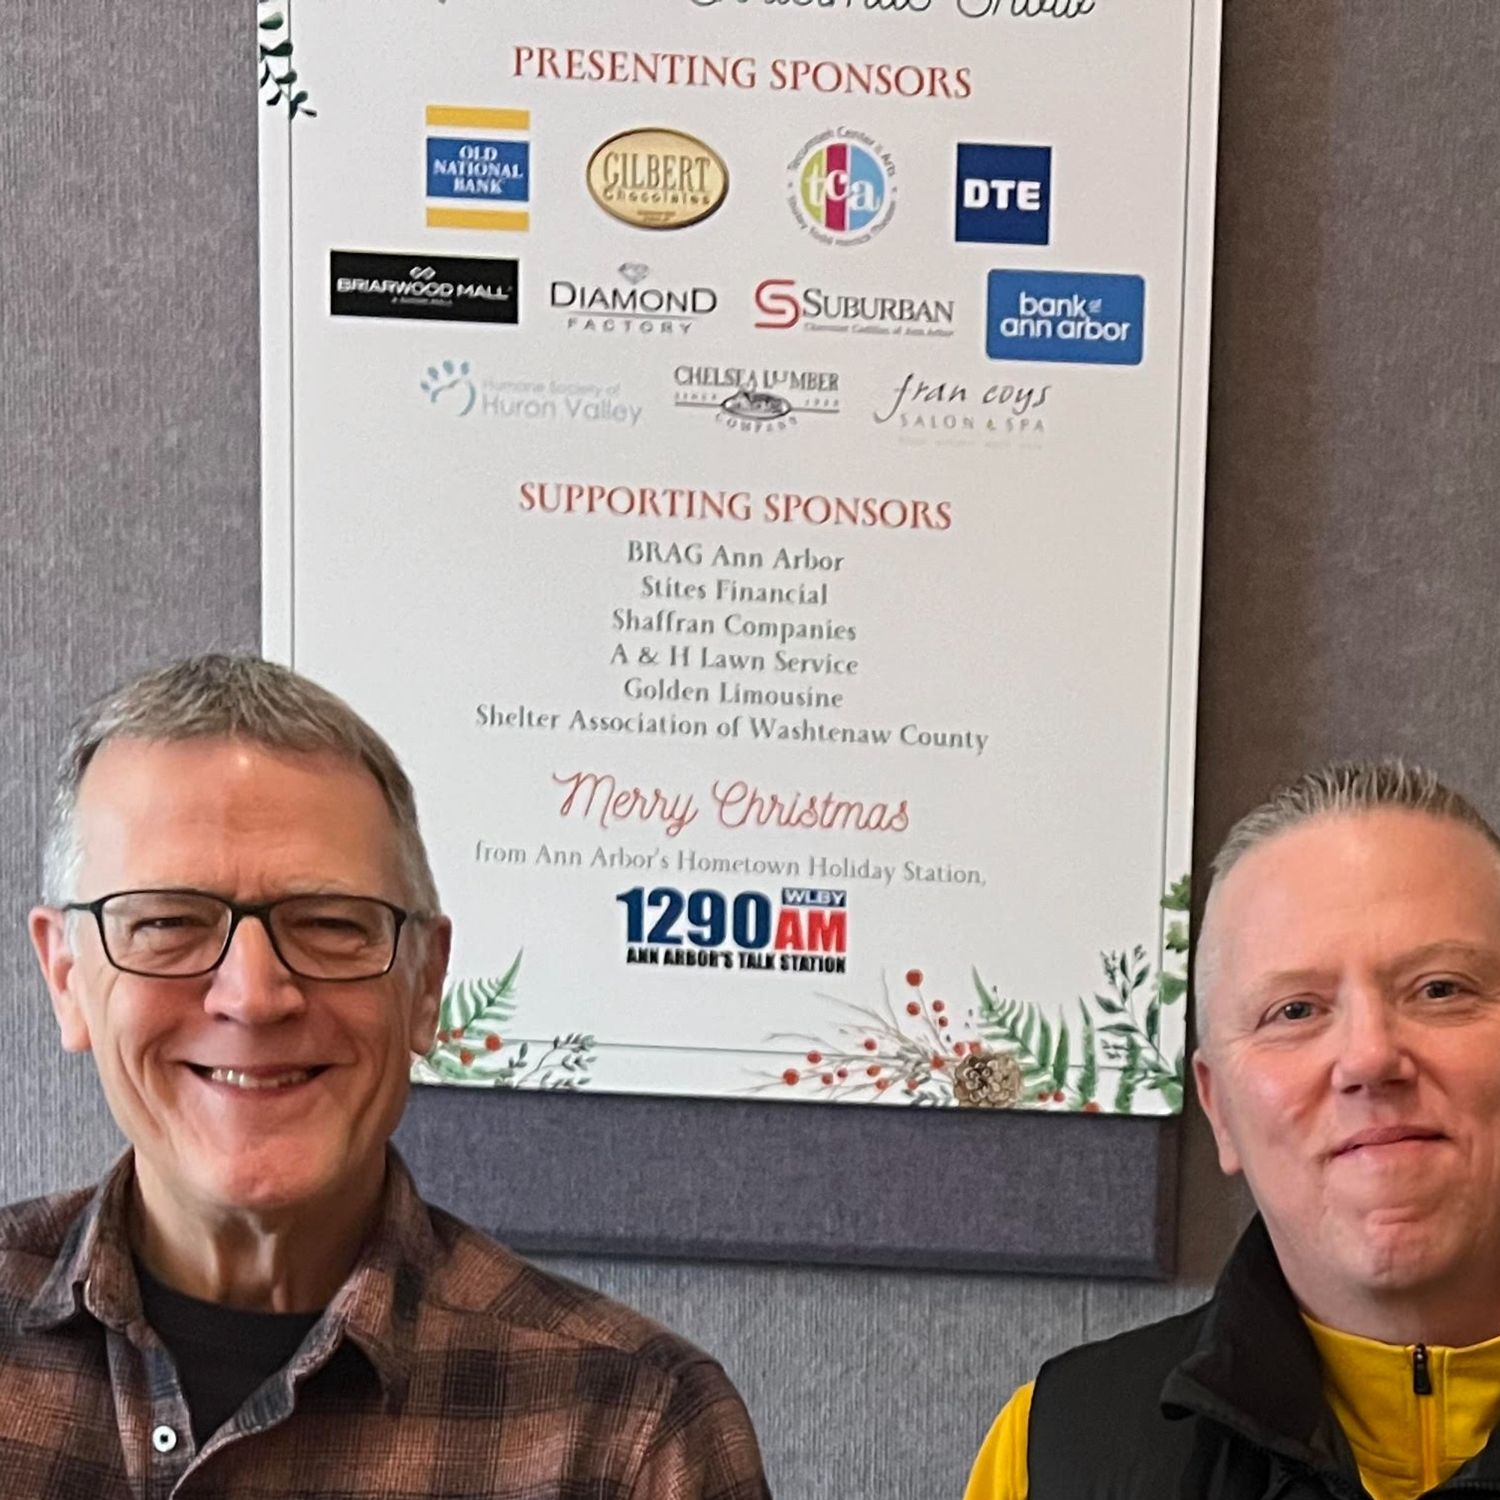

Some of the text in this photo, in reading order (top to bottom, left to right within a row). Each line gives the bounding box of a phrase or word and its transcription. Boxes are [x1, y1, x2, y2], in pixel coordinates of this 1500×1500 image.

[513, 46, 971, 98] PRESENTING SPONSORS
[459, 145, 498, 161] OLD
[434, 159, 523, 179] NATIONAL
[603, 151, 711, 193] GILBERT
[453, 177, 502, 194] BANK
[806, 162, 880, 212] tca
[963, 178, 1040, 210] DTE
[337, 277, 454, 298] BRIARWOOD
[457, 283, 509, 301] MALL
[551, 281, 718, 315] DIAMOND
[1019, 290, 1088, 319] bank
[803, 288, 955, 323] SUBURBAN
[567, 318, 693, 335] FACTORY
[1000, 317, 1131, 342] ann arbor
[763, 369, 840, 392] LUMBER
[481, 394, 643, 425] Huron Valley
[873, 373, 1052, 424] fran coys
[900, 412, 975, 430] SALON
[1005, 416, 1046, 433] SPA
[520, 481, 952, 530] SUPPORTING SPONSORS
[627, 540, 845, 571] BRAG Ann Arbor
[641, 575, 828, 605] Stites Financial
[612, 608, 857, 645] Shaffran Companies
[610, 643, 859, 675] A & H Lawn Service
[624, 677, 843, 708] Golden Limousine
[475, 704, 989, 755] Shelter Association of Washtenaw County
[552, 771, 909, 838] Merry Christmas
[475, 839, 987, 887] from Ann Arbor's Hometown Holiday Station,
[783, 887, 845, 907] WLBY
[616, 886, 773, 950] 1290
[774, 907, 847, 954] AM
[627, 947, 847, 974] ANN ARBOR'S TALK STATION
